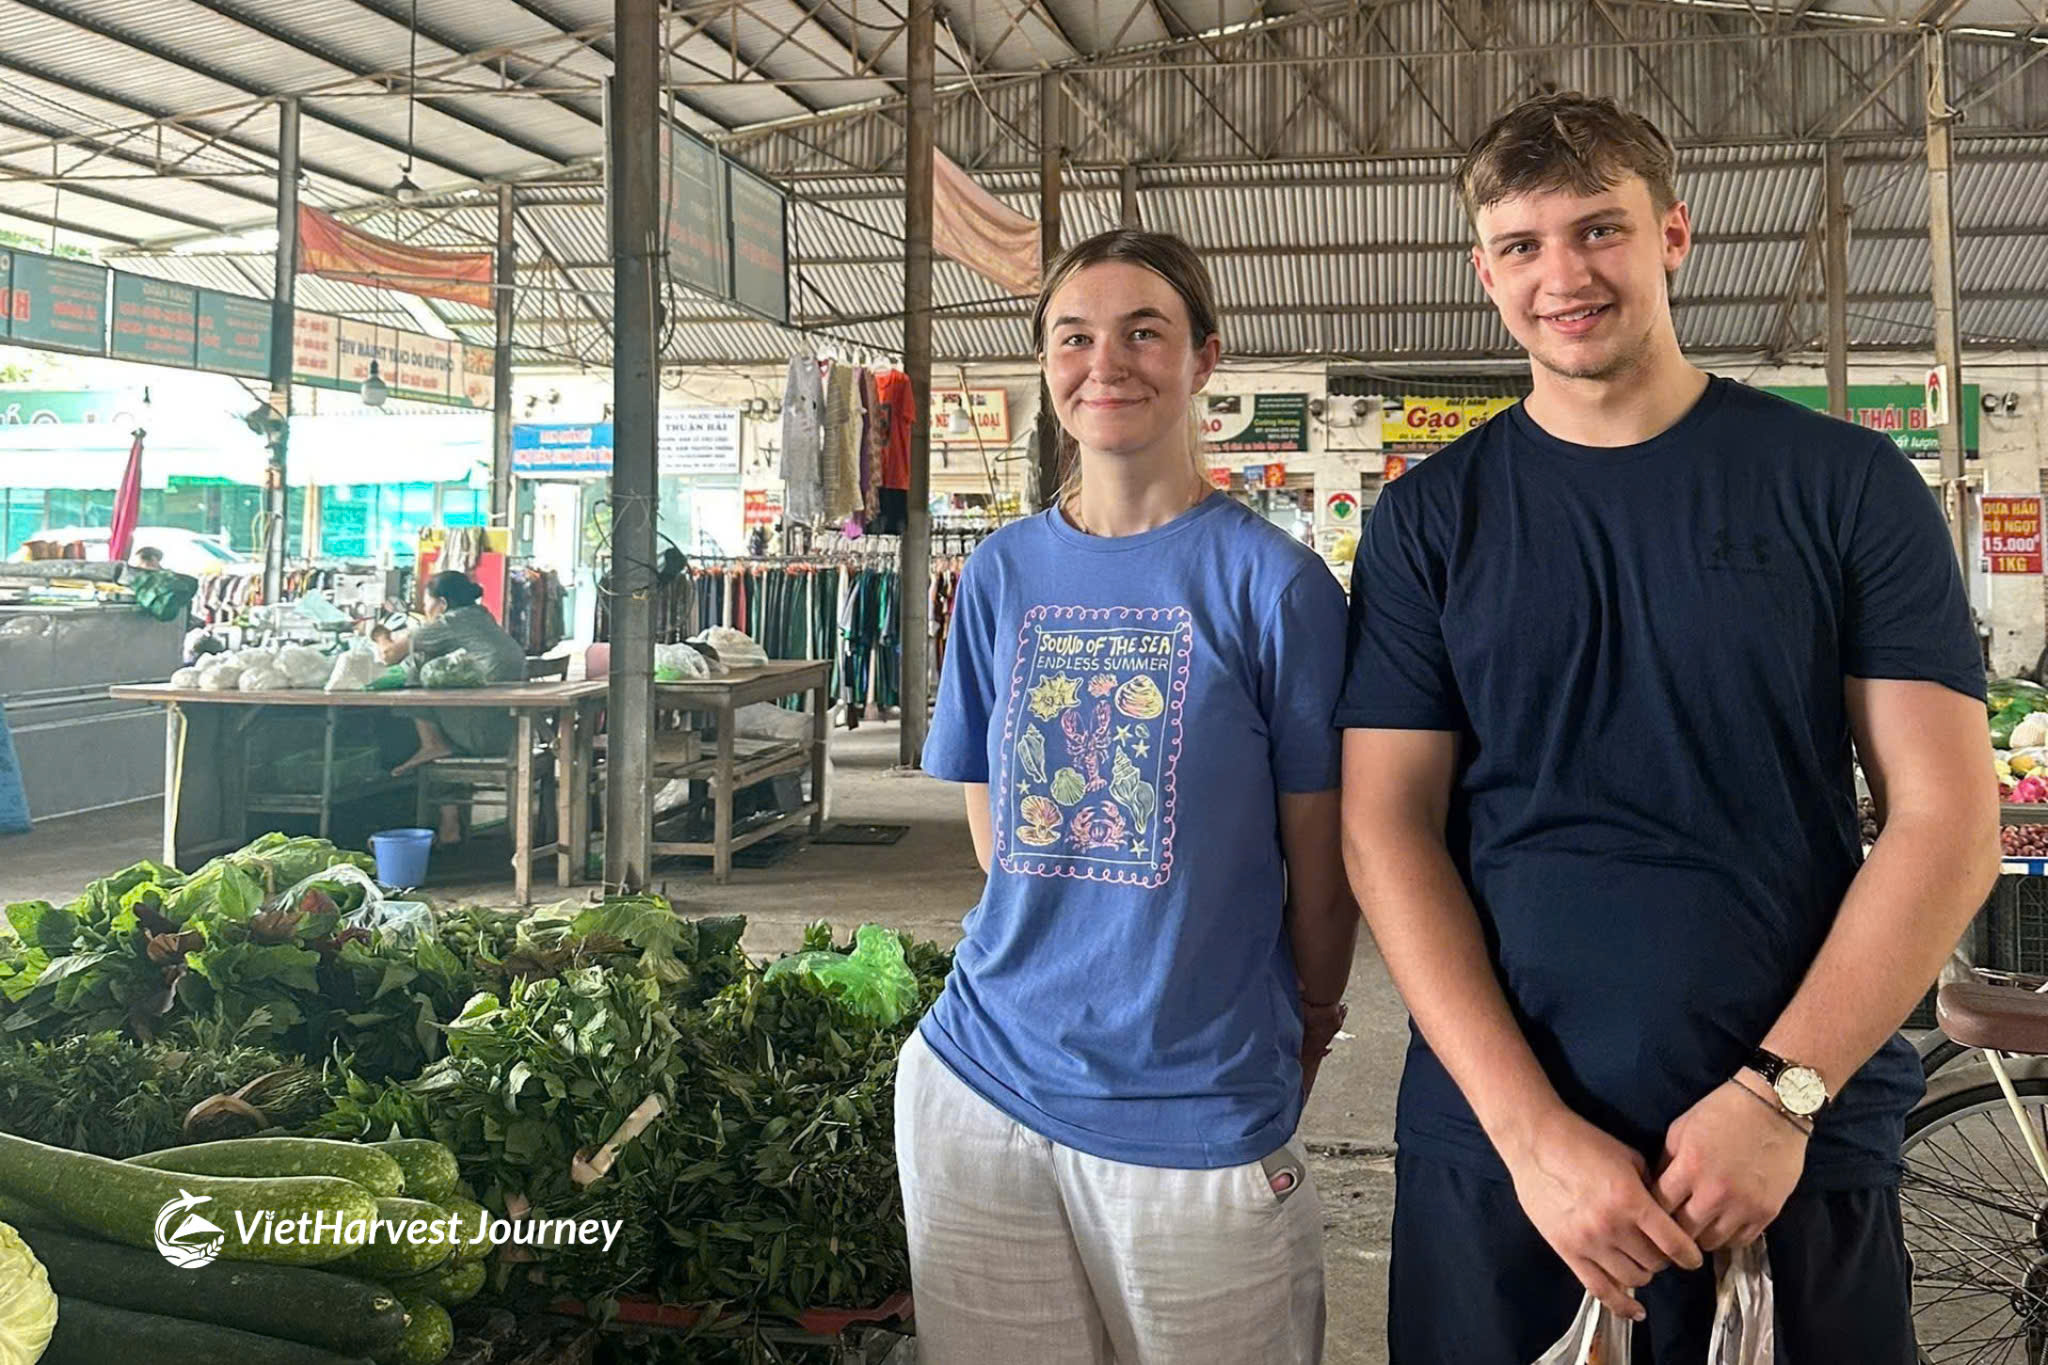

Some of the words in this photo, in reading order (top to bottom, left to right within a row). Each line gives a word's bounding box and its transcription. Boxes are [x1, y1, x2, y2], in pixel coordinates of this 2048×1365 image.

[1407, 406, 1460, 433] Gạo
[1998, 556, 2028, 572] 1KG
[1039, 634, 1084, 656] SOUND
[1086, 636, 1106, 657] OF
[1109, 635, 1140, 656] THE
[1138, 635, 1171, 656] SEA
[1036, 656, 1100, 671] ENDLESS
[1104, 657, 1169, 671] SUMMER
